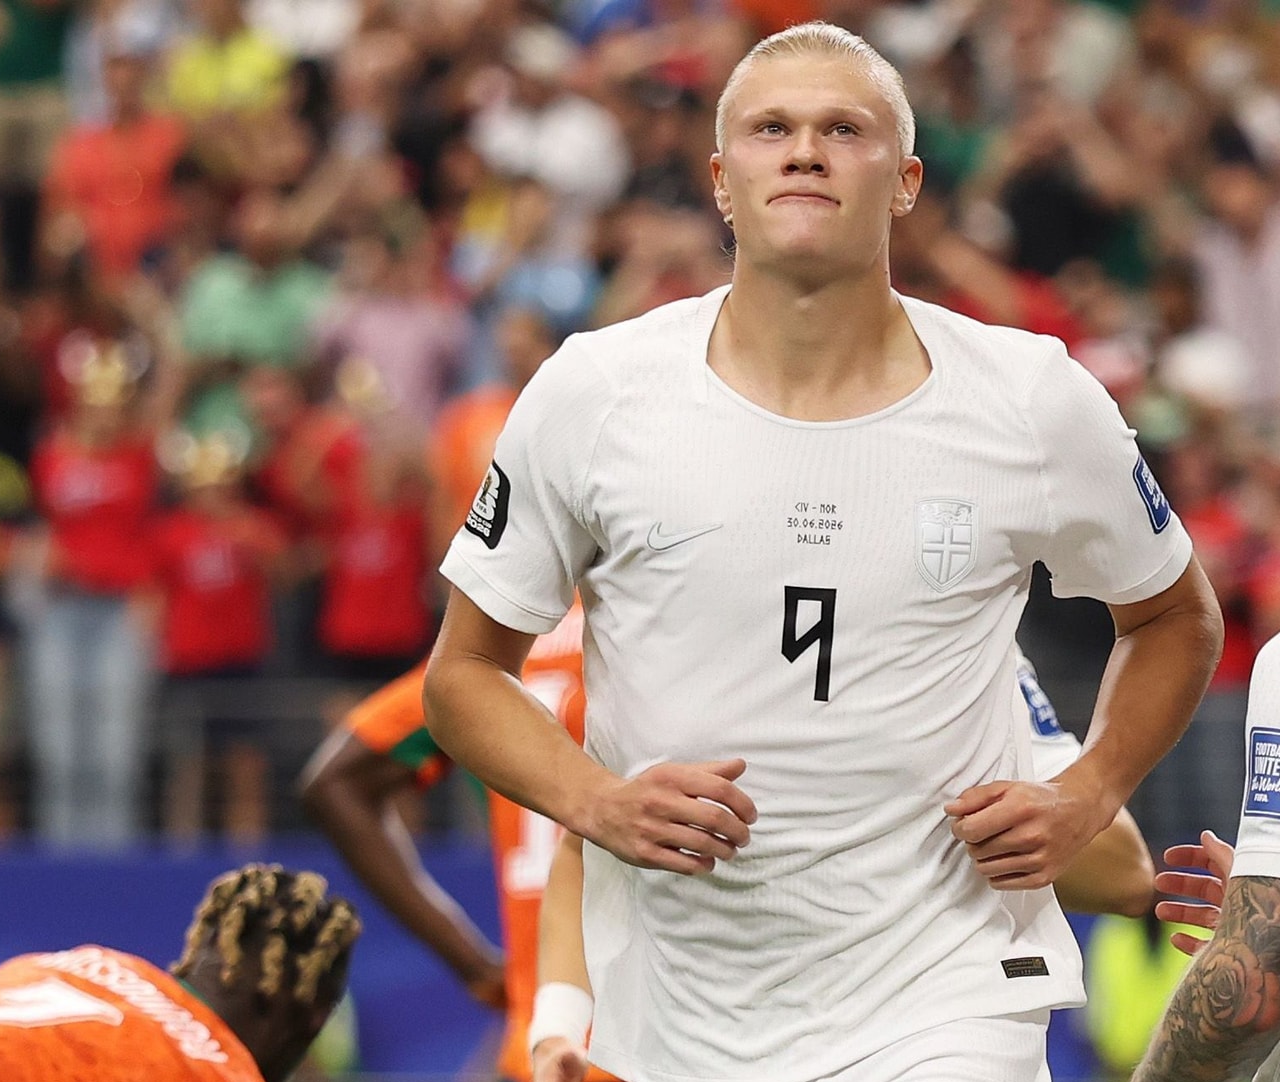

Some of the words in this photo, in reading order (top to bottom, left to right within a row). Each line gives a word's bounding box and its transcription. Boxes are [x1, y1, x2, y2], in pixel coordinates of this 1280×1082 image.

[794, 502, 809, 513] CIV
[819, 503, 837, 514] NOR
[786, 517, 844, 530] 30.06.2026
[796, 533, 831, 546] DALLAS
[781, 585, 837, 702] 9
